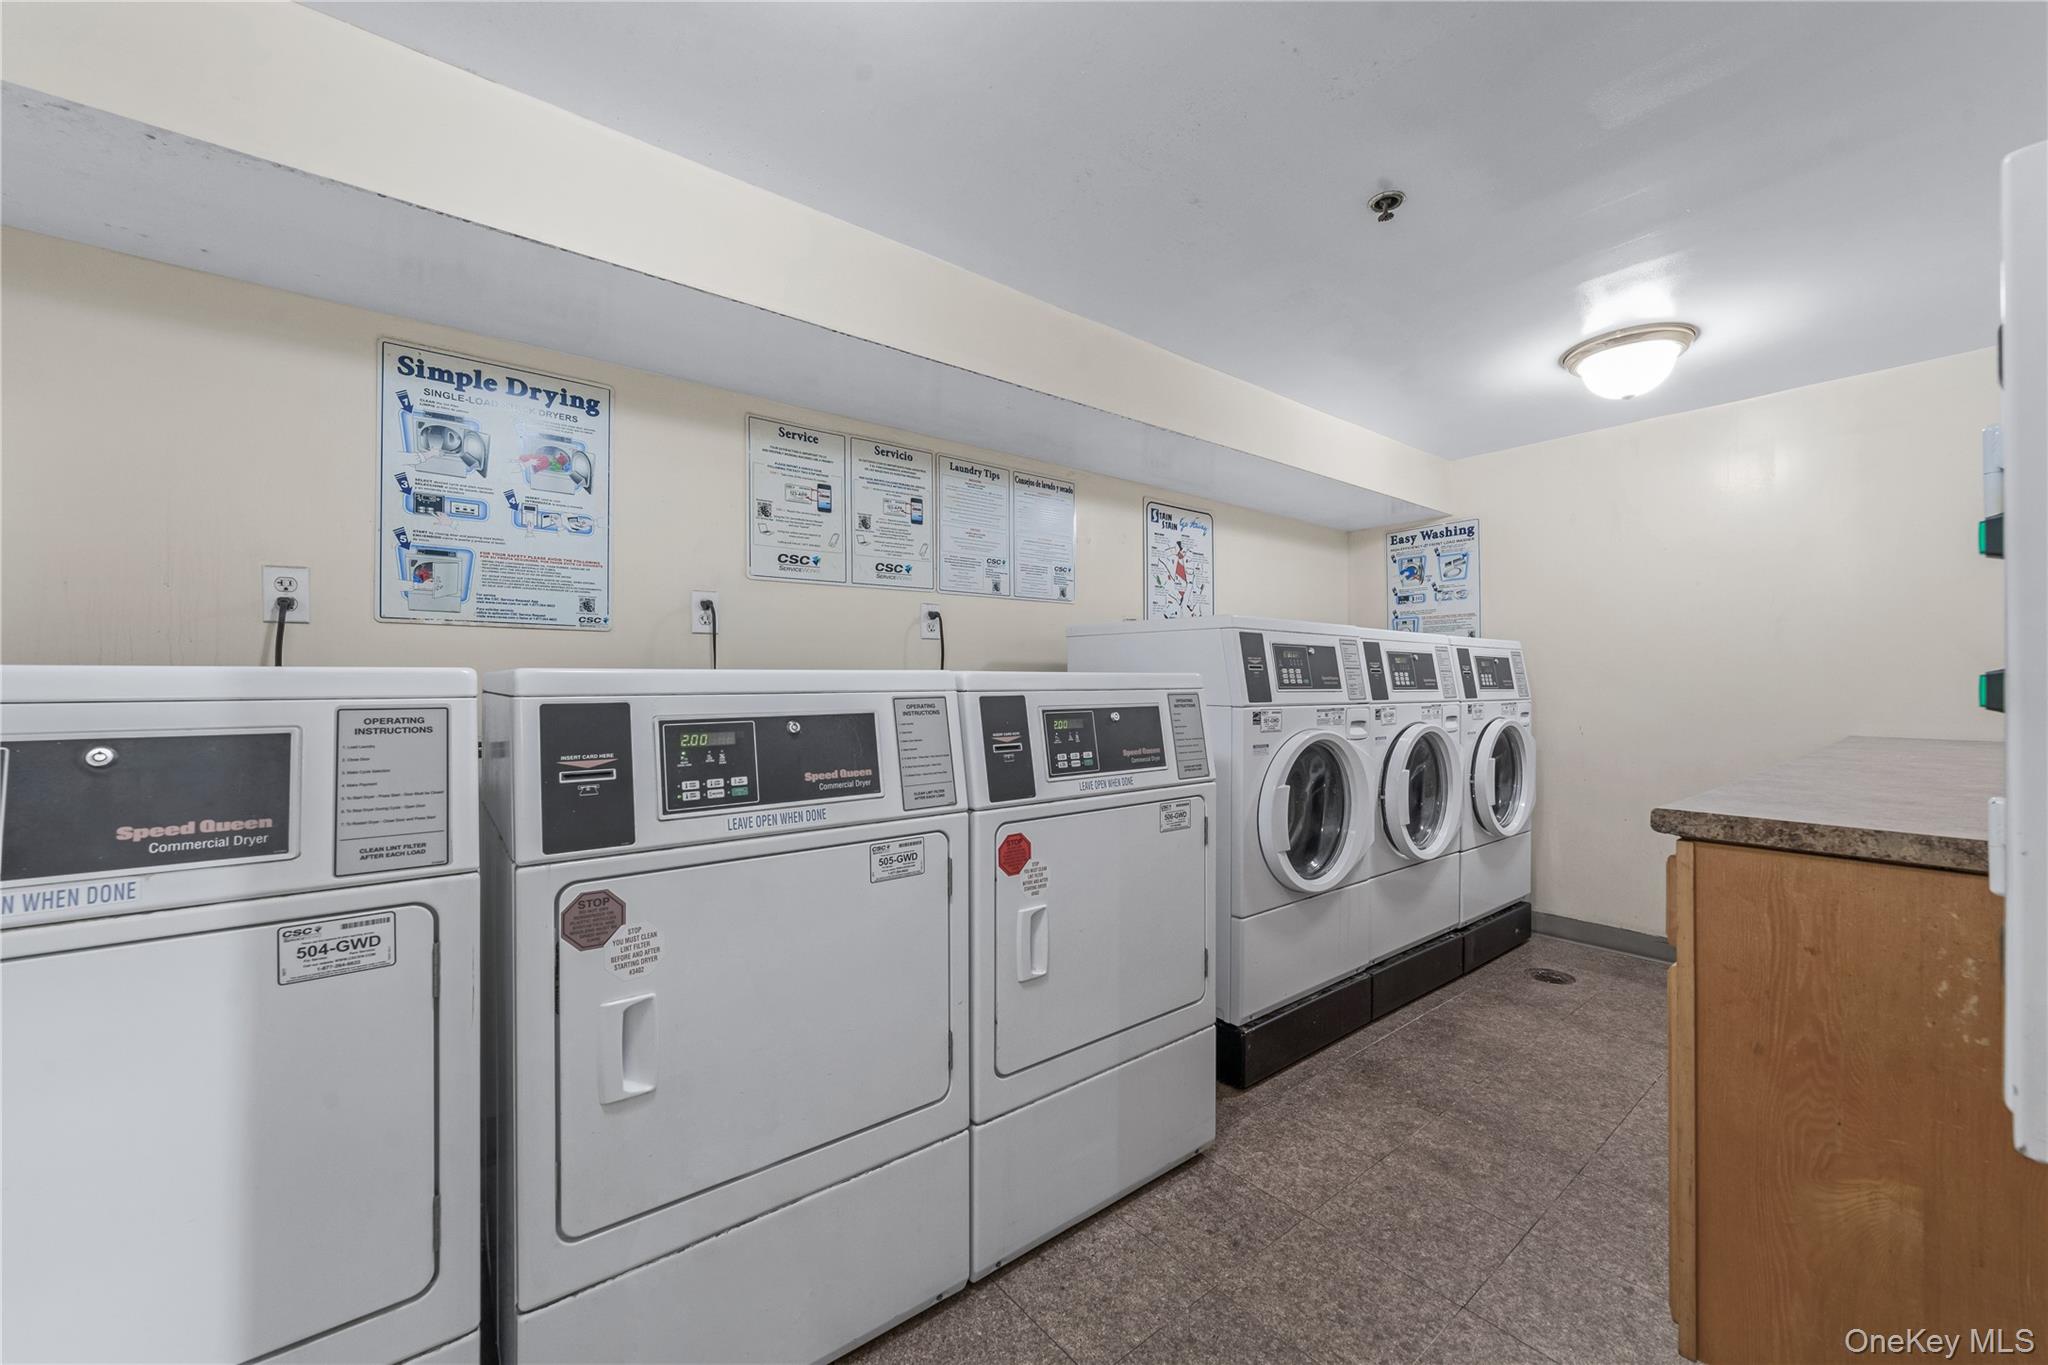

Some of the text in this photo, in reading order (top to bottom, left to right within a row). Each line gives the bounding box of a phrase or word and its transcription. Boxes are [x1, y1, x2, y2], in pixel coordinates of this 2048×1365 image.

[397, 355, 498, 392] Simple
[506, 377, 600, 417] Drying
[538, 409, 578, 423] DRYERS
[778, 426, 819, 444] Service
[874, 445, 913, 462] Servicio
[950, 462, 1000, 481] Laundry Tips
[400, 534, 407, 542] 5
[1391, 526, 1475, 545] Easy Washing
[777, 554, 810, 565] CSC
[875, 563, 903, 573] CSC
[364, 717, 425, 726] OPERATING
[354, 726, 433, 735] INSTRUCTIONS
[681, 734, 707, 746] 2.00
[804, 769, 872, 782] Speed Queen
[819, 779, 871, 791] Commercial Dryer
[1080, 777, 1133, 791] LEAVE OPEN WHEN DONE
[728, 808, 827, 831] LEAVE OPEN WHEN DONE
[116, 817, 273, 842] Speed Queen
[148, 834, 269, 854] Commercial Dryer
[879, 852, 918, 866] 505-GWD
[22, 888, 79, 913] WHEN
[87, 882, 136, 905] DONE
[578, 897, 610, 910] STOP
[282, 927, 312, 937] CSC
[628, 927, 642, 935] STOP
[612, 931, 657, 947] YOU MUST CLEAN
[297, 935, 381, 959] 504-GWD
[620, 941, 651, 953] LINT FILTER
[611, 946, 660, 963] BEFORE AND AFTER
[614, 955, 658, 971] STARTING DRYER
